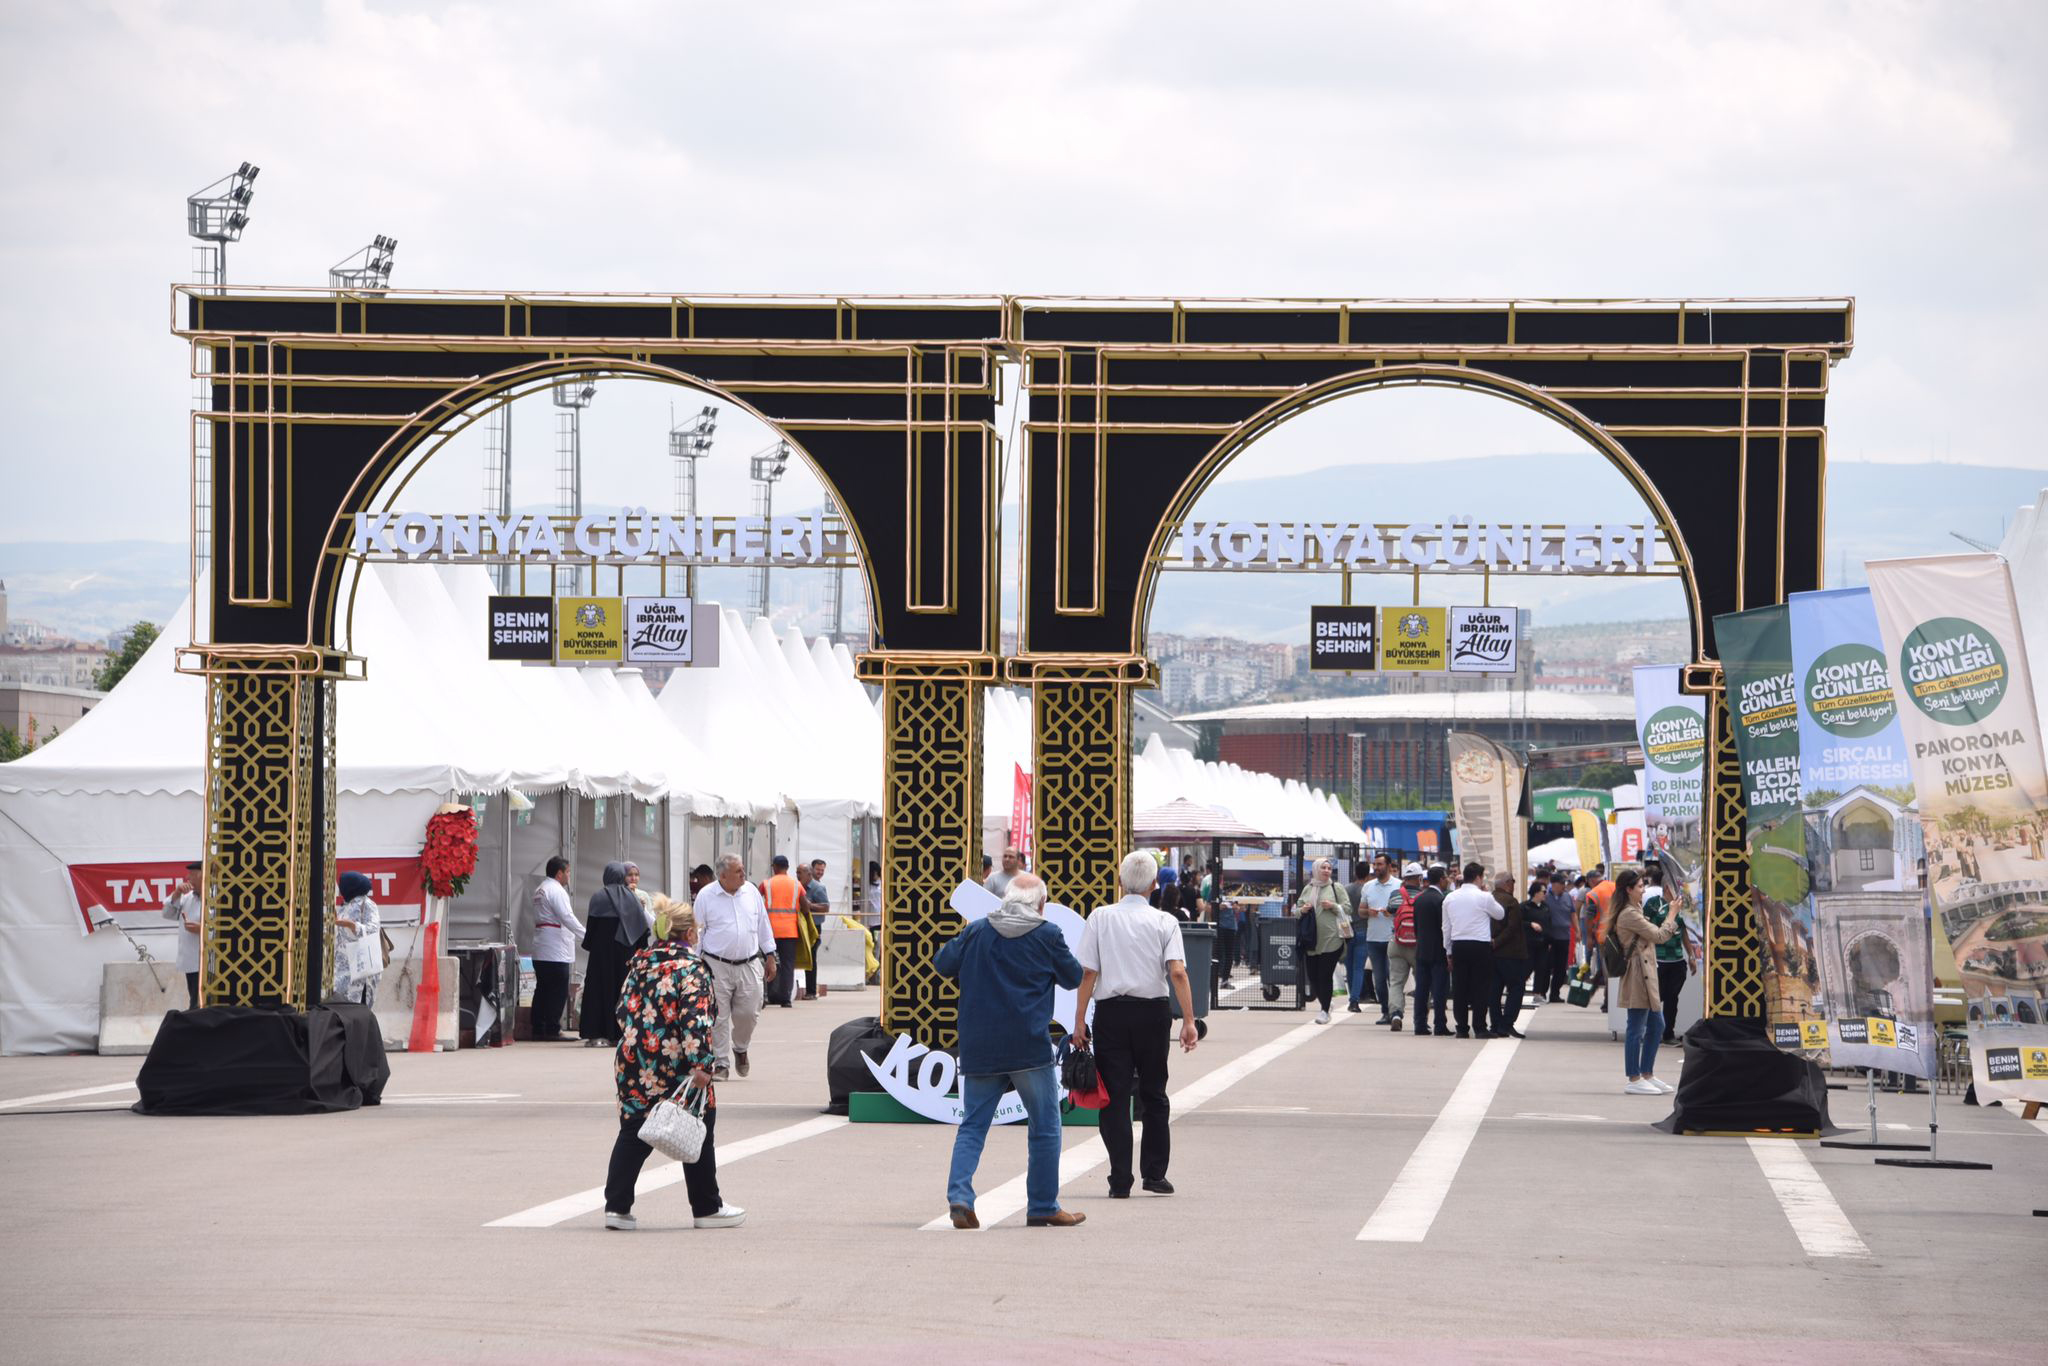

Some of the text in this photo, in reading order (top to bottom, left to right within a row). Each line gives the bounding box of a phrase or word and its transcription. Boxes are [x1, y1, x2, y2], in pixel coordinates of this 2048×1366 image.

[355, 506, 823, 559] KONYA GÜNLERİ
[1182, 514, 1656, 567] KONYA GÜNLERİ
[644, 602, 677, 614] UĞUR
[493, 612, 549, 628] BENİM
[636, 614, 685, 624] İBRAHİM
[1467, 612, 1501, 624] UĞUR
[493, 630, 549, 645] ŞEHRİM
[577, 631, 605, 639] KONYA
[631, 623, 689, 652] Altay
[1315, 621, 1372, 637] BENİM
[1460, 624, 1510, 634] İBRAHİM
[563, 638, 618, 650] BÜYÜKŞEHİR
[1315, 639, 1372, 655] ŞEHRİM
[1400, 641, 1427, 649] KONYA
[1454, 633, 1513, 662] Altay
[1909, 633, 1983, 664] KONYA
[1385, 648, 1441, 660] BÜYÜKŞEHİR
[1908, 643, 1996, 683] GÜNLERİ
[1815, 659, 1883, 683] KONYA
[1811, 669, 1892, 700] GÜNLERİ
[1917, 668, 2001, 694] Tüm Güzellikleriyle
[1817, 701, 1836, 710] Tüm
[1923, 681, 2001, 712] Seni bekliyor!
[1744, 706, 1797, 724] Tüm Güzellikle
[1821, 703, 1893, 725] Seni bekliyor!
[1651, 717, 1698, 735] KONYA
[1748, 718, 1798, 738] Seni bekliy
[1647, 725, 1704, 746] GÜNLERİ
[1914, 728, 2026, 759] PANOROMA
[1822, 745, 1892, 765] SIRÇALI
[1941, 753, 2007, 775] KONYA
[1808, 759, 1909, 782] MEDRESESİ
[1651, 777, 1700, 792] 80 BİND
[1755, 771, 1801, 790] ECDA
[1945, 768, 2014, 796] MÜZESİ
[1663, 805, 1699, 817] PARKI
[1988, 1055, 2019, 1066] BENİM
[1990, 1064, 2020, 1074] ŞEHRİM
